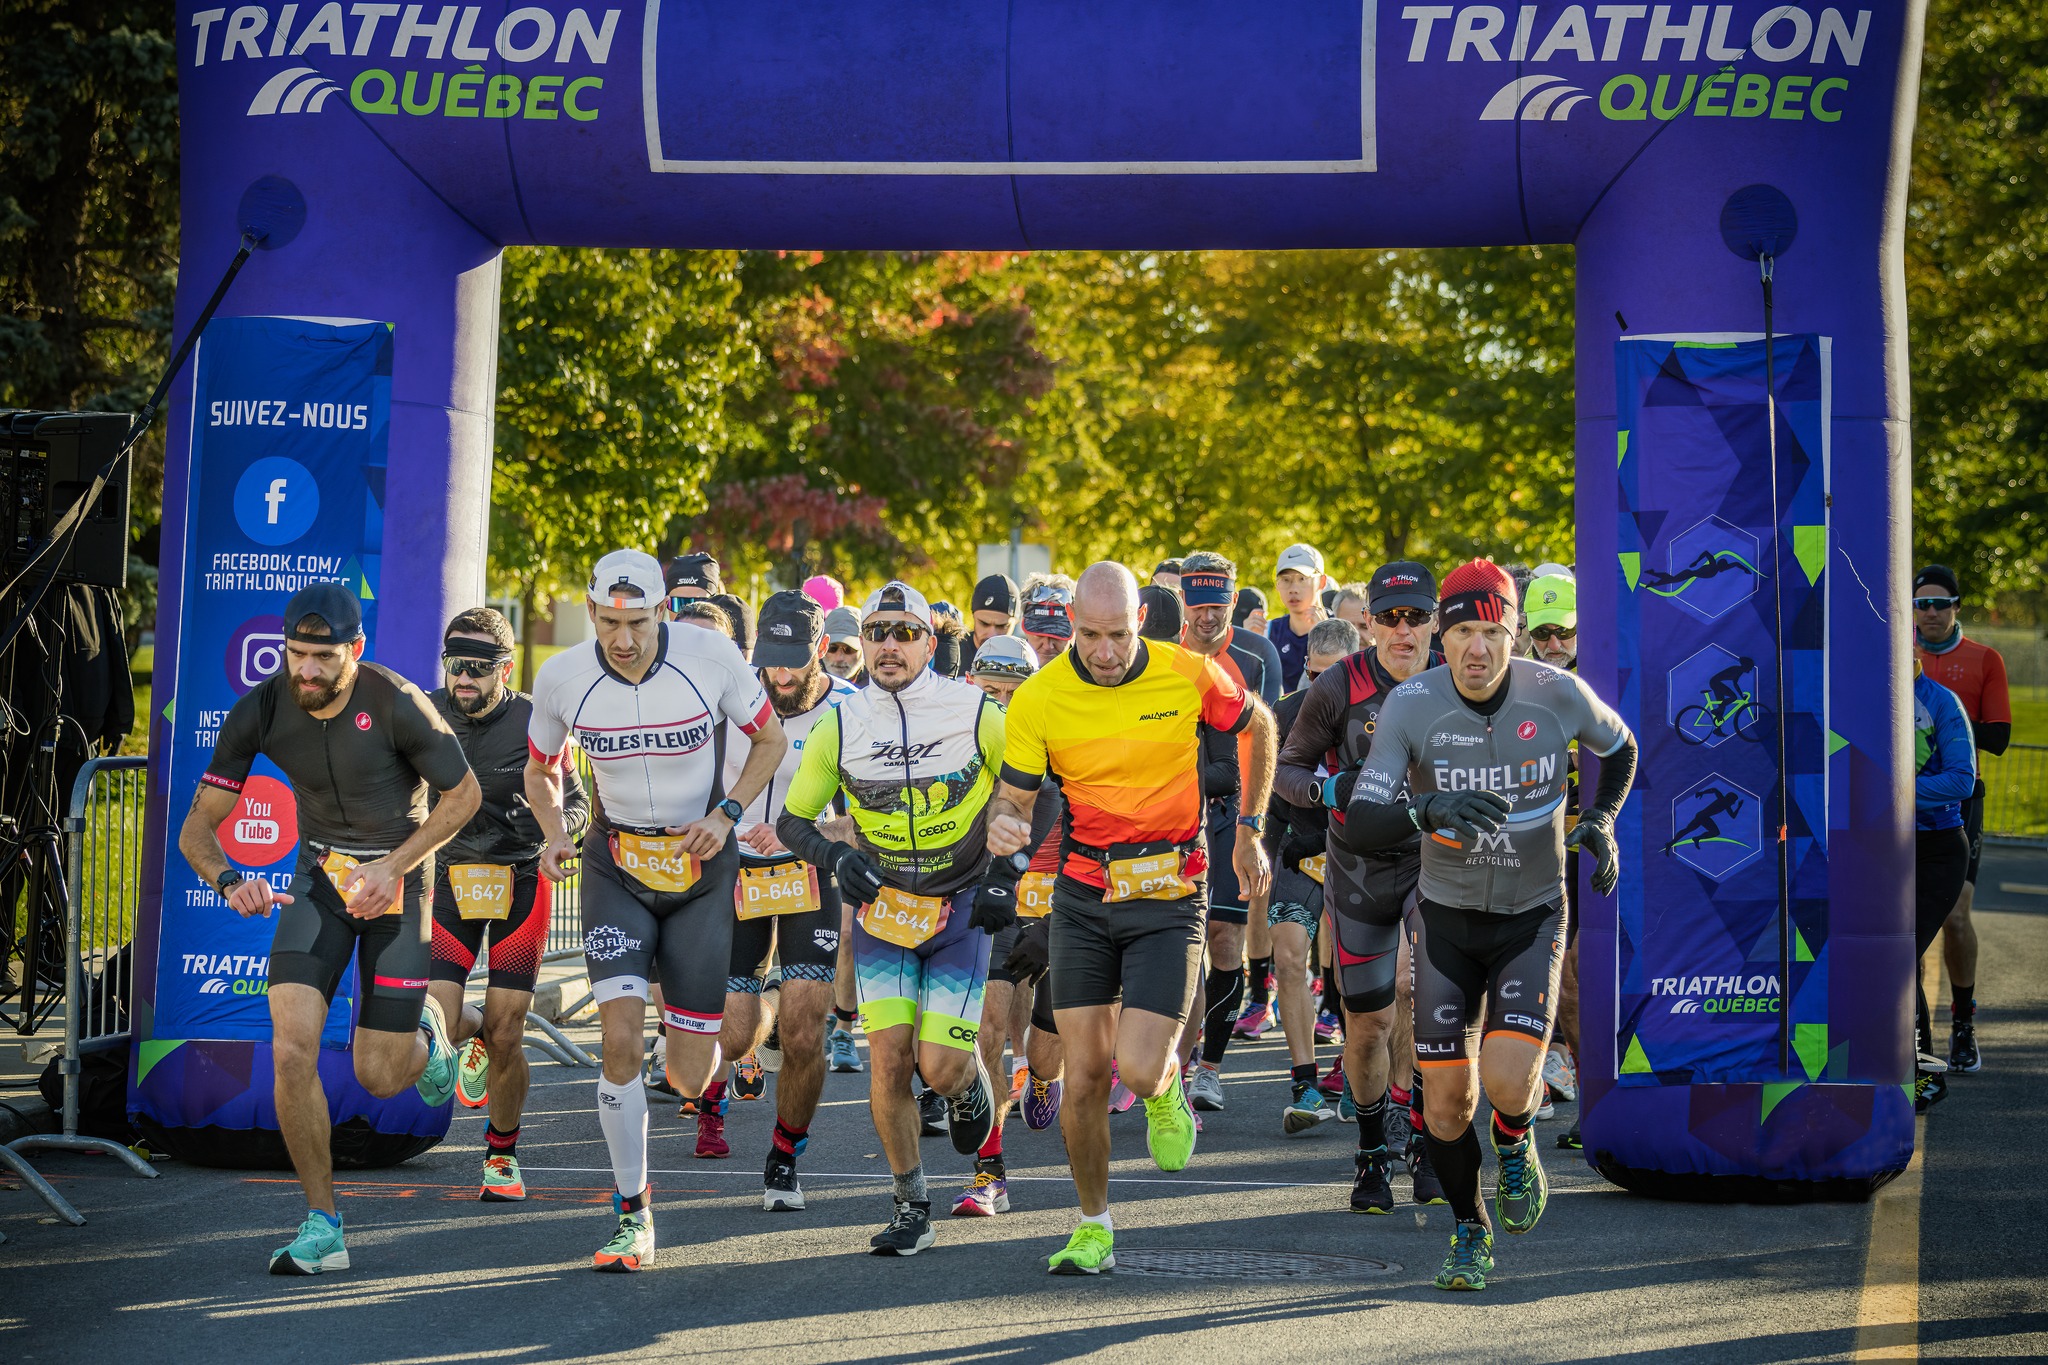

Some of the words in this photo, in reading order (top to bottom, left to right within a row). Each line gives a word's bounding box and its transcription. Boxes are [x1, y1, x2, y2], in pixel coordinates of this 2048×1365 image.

[191, 1, 621, 66] TRIATHLON
[1402, 4, 1872, 66] TRIATHLON
[349, 63, 603, 122] QUÉBEC
[1599, 64, 1849, 123] QUÉBEC
[210, 400, 368, 430] SUIVEZ-NOUS
[212, 553, 342, 574] FACEBOOK.COM/
[1191, 578, 1225, 588] ORANGE
[1397, 688, 1431, 697] CHROME
[1139, 709, 1179, 721] AVALANCHE
[580, 733, 640, 753] CYCLES
[643, 721, 708, 749] FLEURY
[1361, 768, 1396, 788] Rally
[244, 797, 271, 817] You
[240, 821, 272, 840] Tube
[872, 830, 906, 843] CORIMA
[626, 852, 684, 875] D-643
[1465, 855, 1521, 868] RECYCLING
[454, 883, 505, 902] D-647
[748, 879, 804, 902] D-646
[874, 900, 930, 933] D-644
[606, 937, 642, 951] FLEURY
[1651, 975, 1781, 996] TRIATHLON
